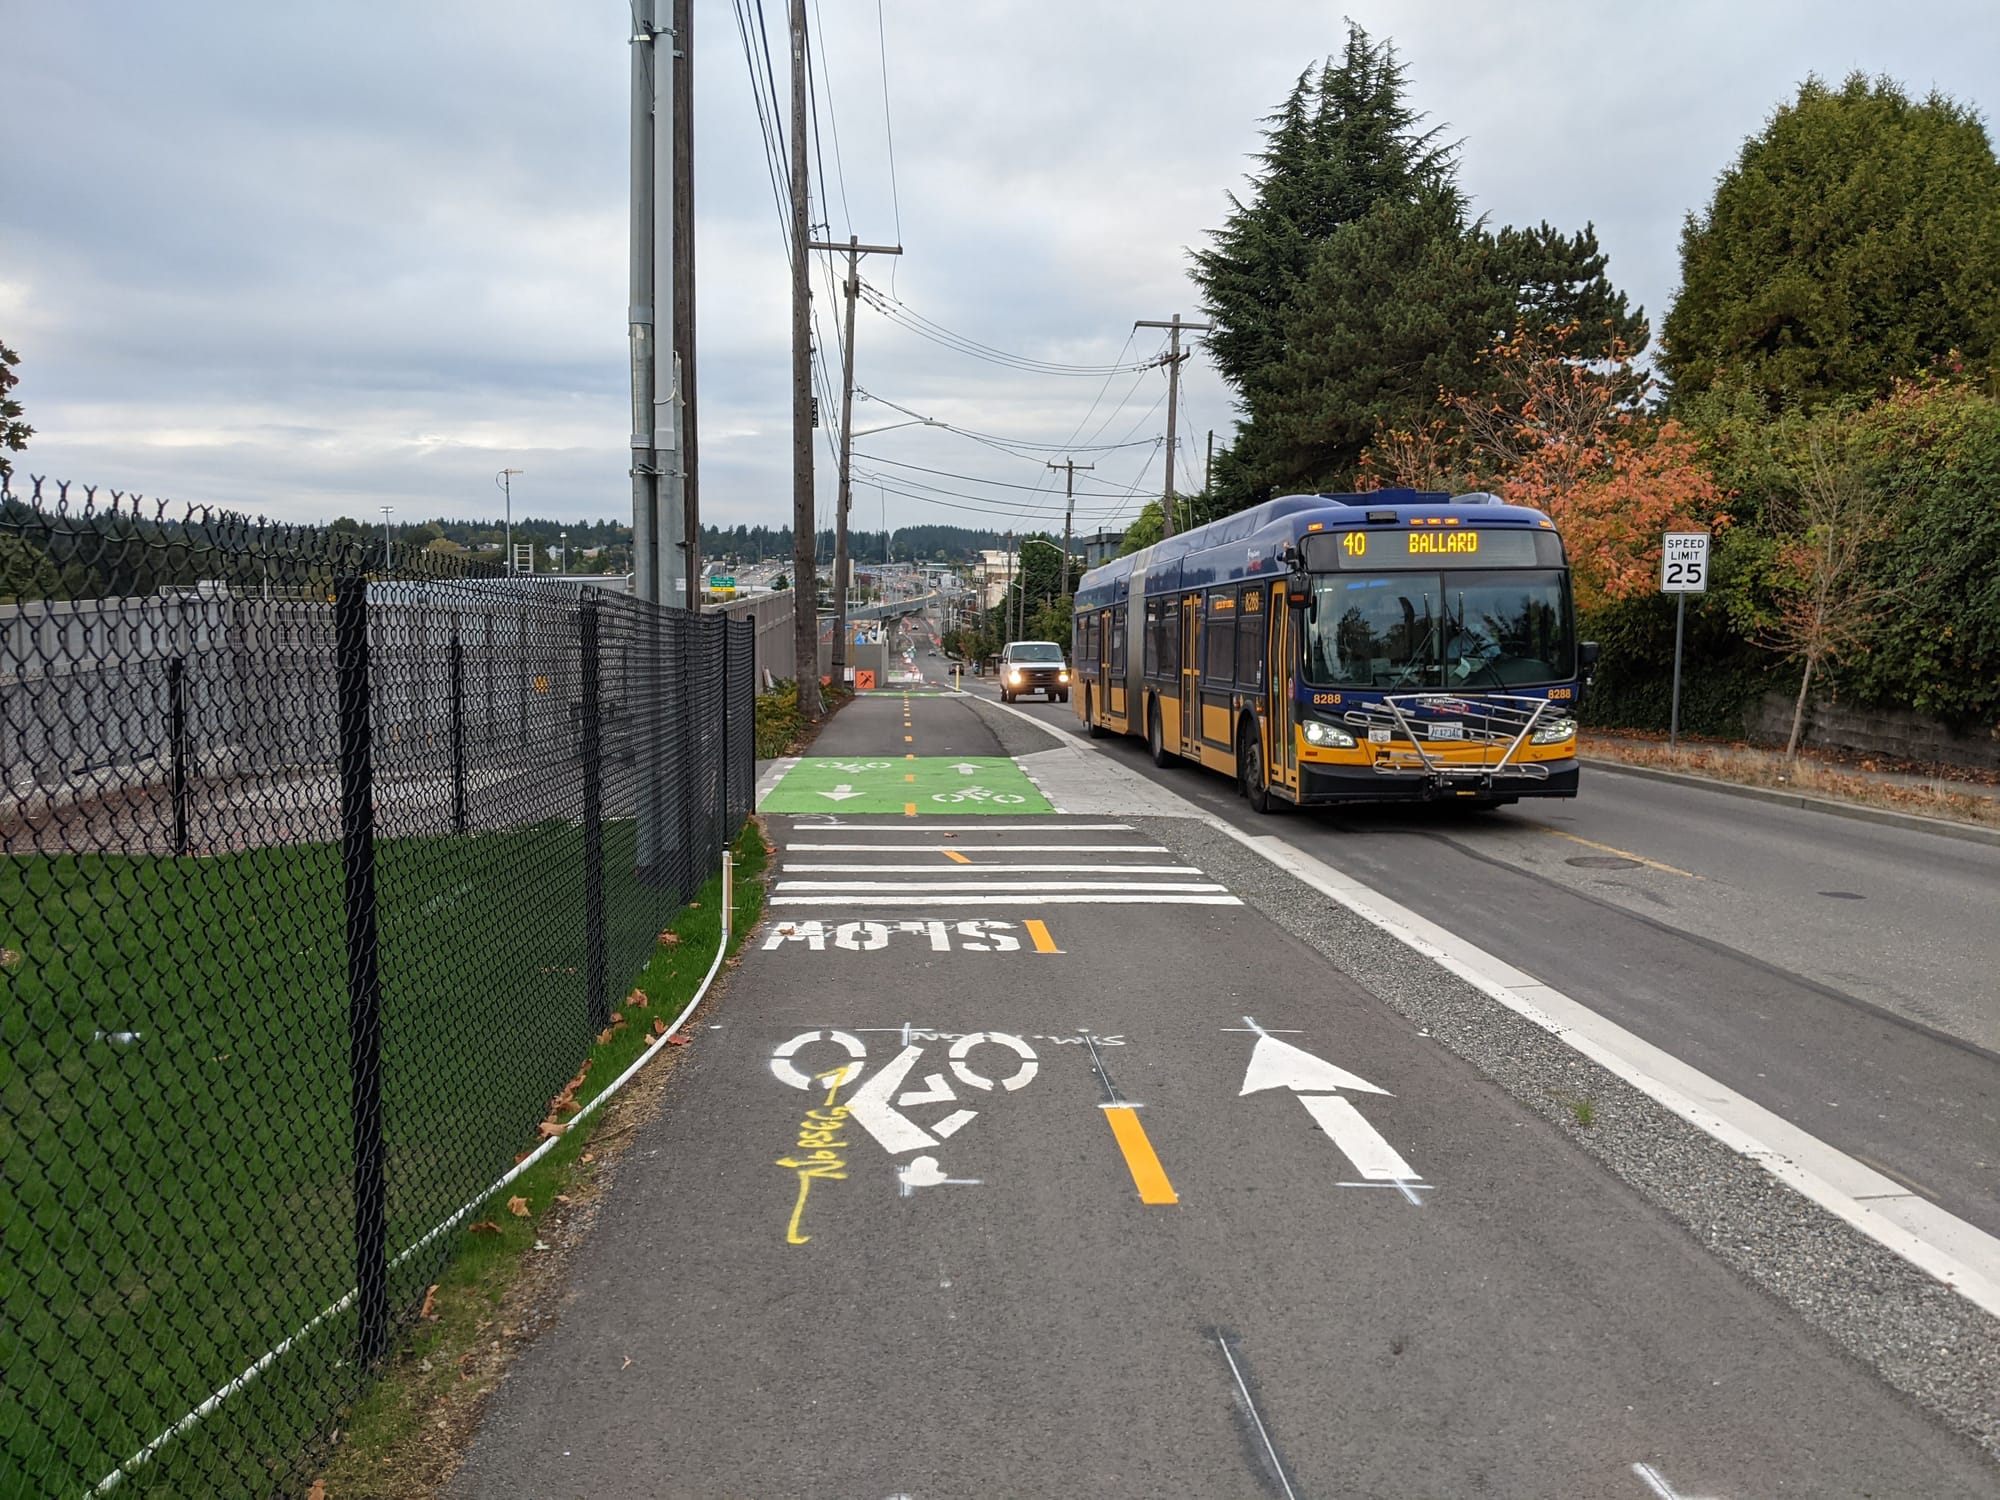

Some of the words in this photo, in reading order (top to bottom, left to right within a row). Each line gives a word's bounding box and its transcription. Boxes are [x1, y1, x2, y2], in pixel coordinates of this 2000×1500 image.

[1343, 532, 1366, 556] 40
[1408, 532, 1478, 553] BALLARD
[1667, 538, 1705, 549] SPEED
[1670, 551, 1700, 561] LIMIT
[1667, 562, 1702, 584] 25
[1313, 693, 1342, 705] 8288
[1547, 688, 1571, 700] 8288
[761, 920, 1021, 953] SLOW
